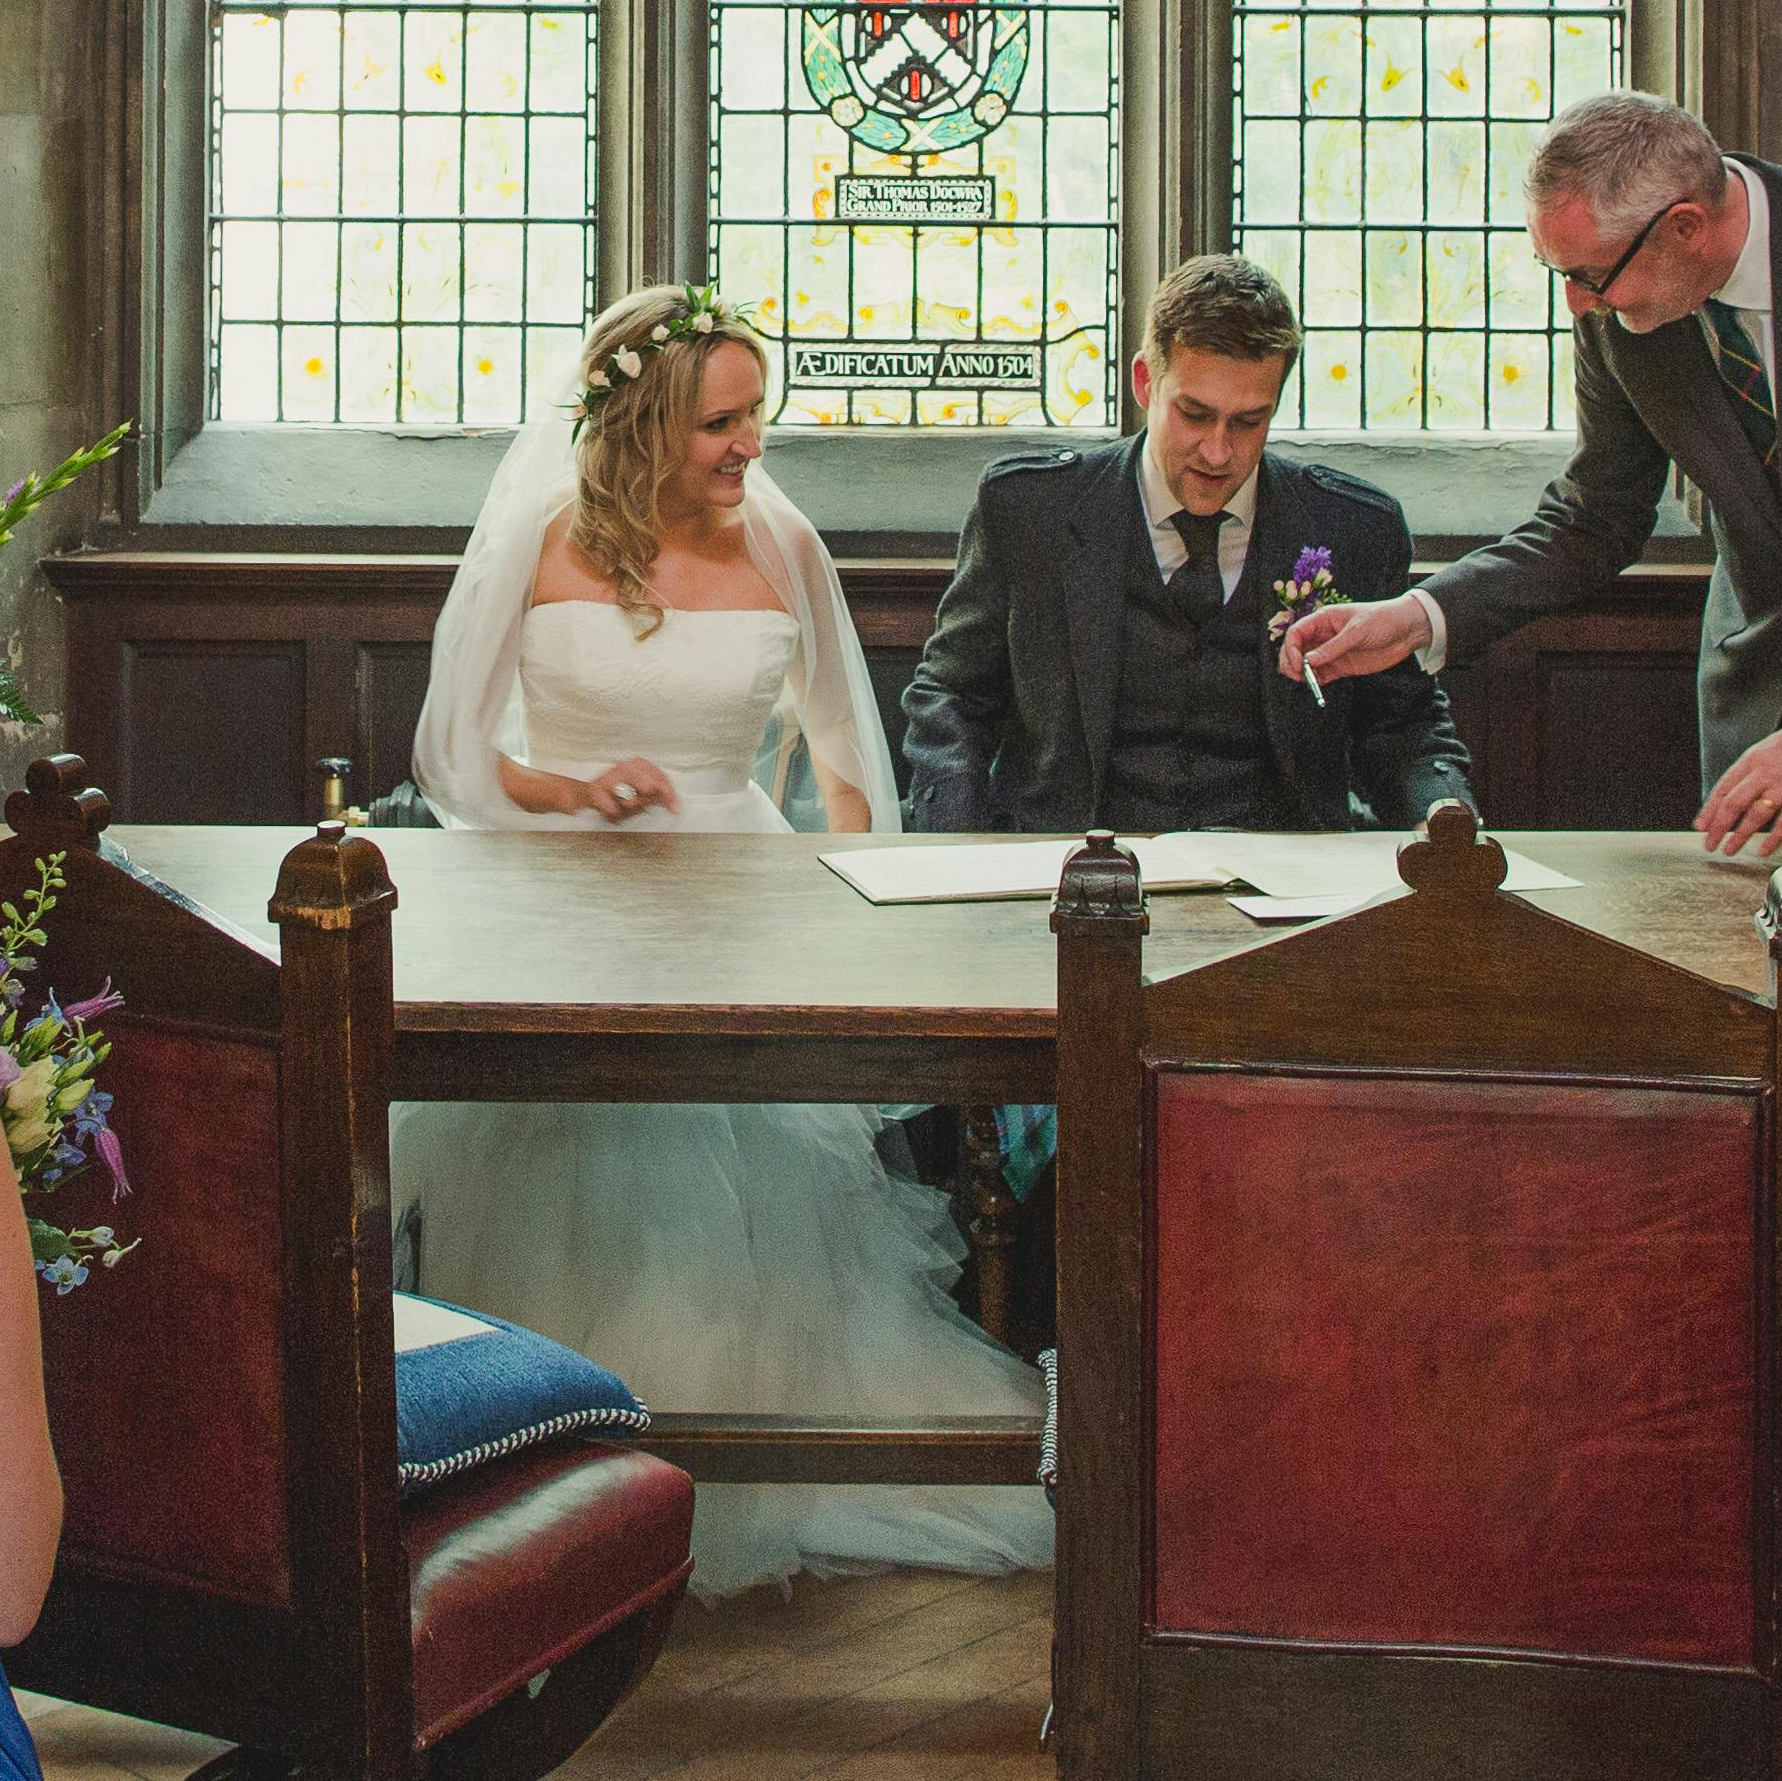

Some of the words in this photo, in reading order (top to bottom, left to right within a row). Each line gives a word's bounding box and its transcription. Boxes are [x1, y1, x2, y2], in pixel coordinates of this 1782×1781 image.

[848, 184, 875, 200] SIR
[876, 184, 929, 200] THOMAS
[929, 184, 984, 200] DOCWRA
[847, 200, 892, 213] GRAND
[892, 200, 928, 213] PRIOR
[930, 200, 983, 214] 1501-1527
[796, 351, 935, 377] ÆDIFICATUM
[938, 352, 995, 378] ANNO
[997, 355, 1034, 378] 1504
